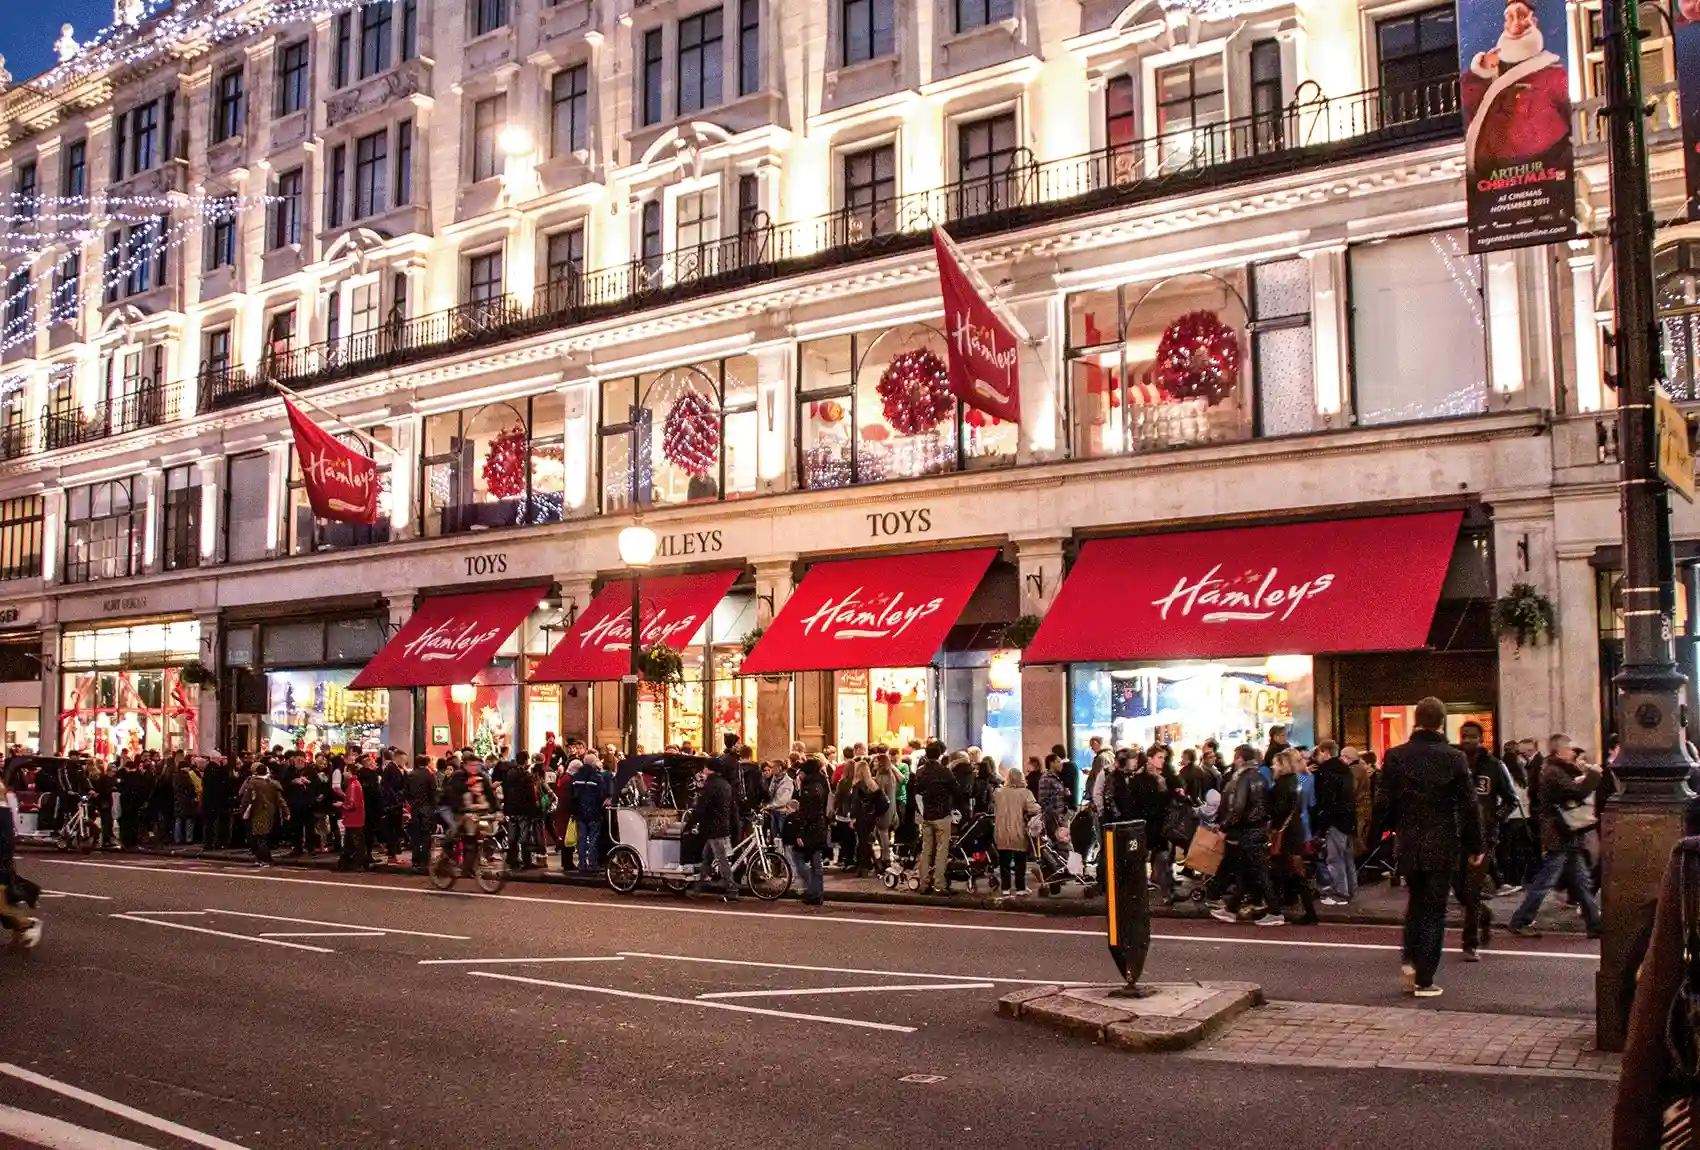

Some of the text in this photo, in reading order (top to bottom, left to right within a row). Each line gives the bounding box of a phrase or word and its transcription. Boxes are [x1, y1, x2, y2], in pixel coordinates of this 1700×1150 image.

[1477, 167, 1557, 191] CHRISTMAS
[1490, 161, 1543, 180] ARTHUR
[1490, 197, 1550, 213] NOVEMBER 2011
[1498, 188, 1543, 203] AT CINEMAS
[952, 307, 1017, 389] Hamleys
[304, 447, 375, 499] Hamleys
[866, 508, 932, 537] TOYS
[652, 529, 723, 557] MLEYS
[464, 553, 507, 576] TOYS
[1152, 563, 1336, 622] Hamleys
[800, 586, 944, 639] Hamleys
[402, 617, 501, 661] Hamleys
